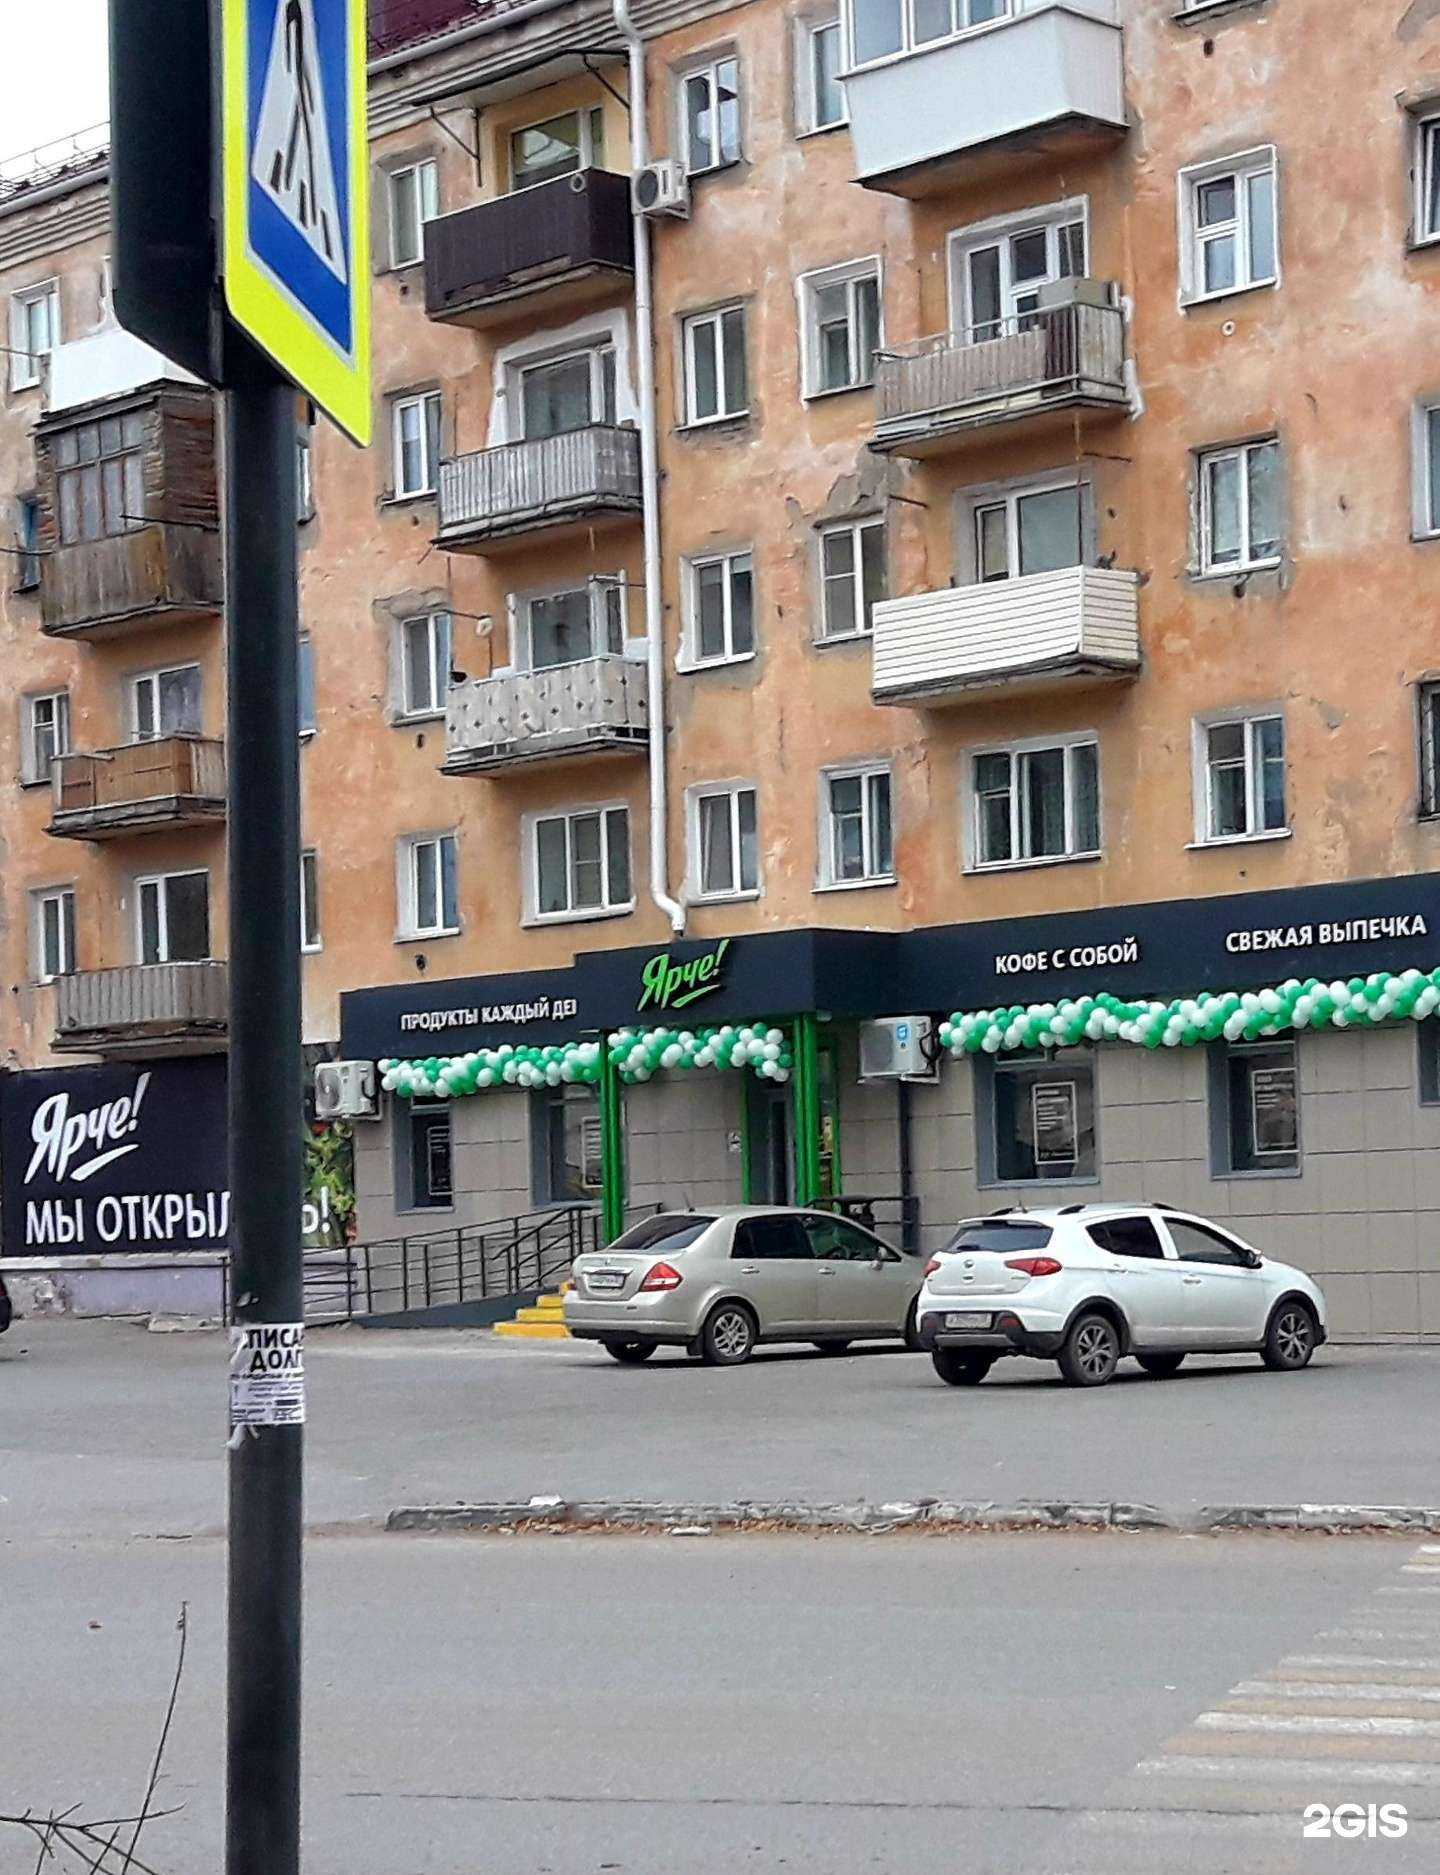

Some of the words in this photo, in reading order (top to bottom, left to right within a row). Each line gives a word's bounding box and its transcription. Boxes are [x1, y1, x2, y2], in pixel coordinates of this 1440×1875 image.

[995, 949, 1048, 975] КОФЕ
[1052, 949, 1066, 969] С
[1069, 936, 1138, 967] СОБОЙ
[1225, 924, 1313, 954] СВЕЖАЯ
[1319, 914, 1428, 944] ВЫПЕЧКА
[637, 938, 731, 1011] Ярче!
[400, 1007, 479, 1032] ПРОДУКТЫ
[481, 996, 550, 1025] КАЖДЫЙ
[24, 1071, 153, 1185] Ярче!
[26, 1200, 85, 1246] МЫ
